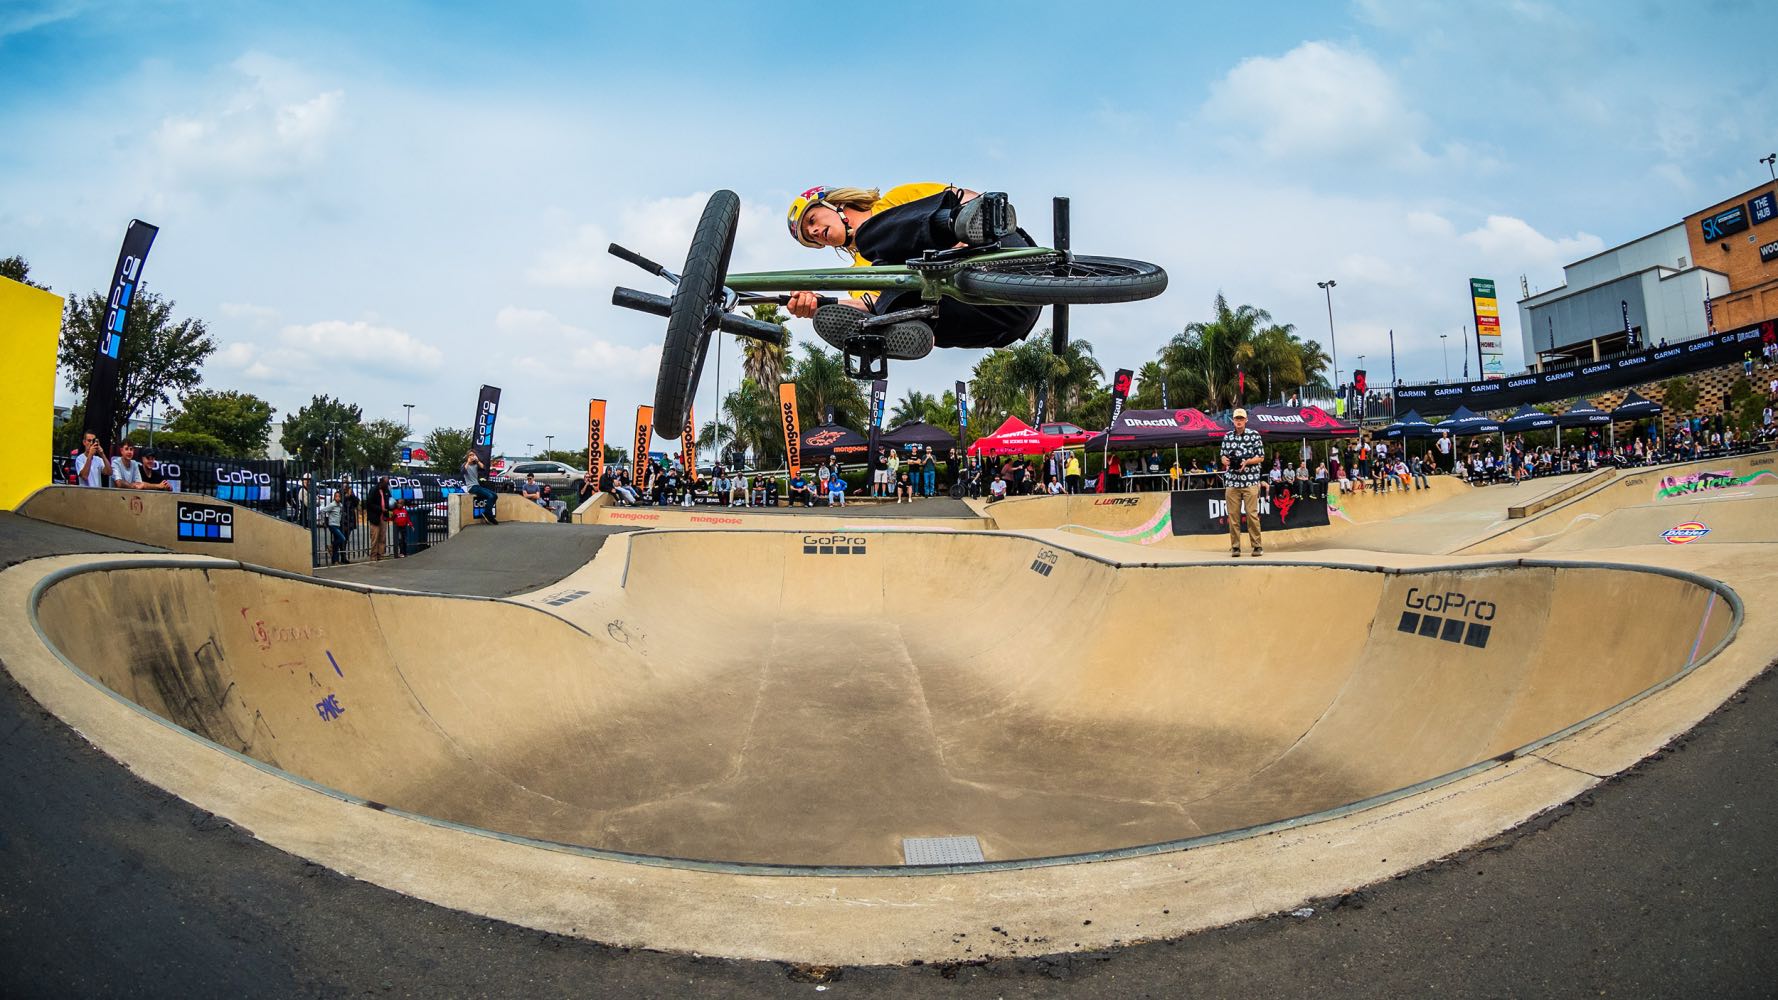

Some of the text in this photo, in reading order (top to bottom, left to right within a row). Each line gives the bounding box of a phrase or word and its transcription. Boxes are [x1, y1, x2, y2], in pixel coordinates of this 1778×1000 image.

[1754, 197, 1769, 210] THE
[1756, 207, 1771, 220] HUB
[101, 255, 134, 355] GoPro
[1737, 328, 1760, 342] DRAGON
[1688, 340, 1714, 352] GARMIN
[1654, 347, 1681, 360] GARMIN
[1618, 356, 1646, 367] GARMIN
[1582, 363, 1610, 375] GARMIN
[1545, 371, 1574, 382] GARMIN
[1471, 383, 1499, 393] GARMIN
[1508, 378, 1537, 388] GARMIN
[1398, 390, 1427, 398] GARMIN
[1434, 387, 1463, 396] GARMIN
[476, 400, 490, 446] GoPro
[1124, 418, 1178, 427] DRAGON
[1256, 414, 1305, 423] DRAGON
[783, 402, 799, 467] mongoose
[635, 424, 648, 486] mongoose
[216, 467, 270, 484] GoPro
[179, 507, 232, 524] GoPro
[610, 511, 660, 521] mongoose
[690, 515, 743, 525] mongoose
[803, 535, 866, 545] GoPro
[1405, 587, 1496, 621] GoPro
